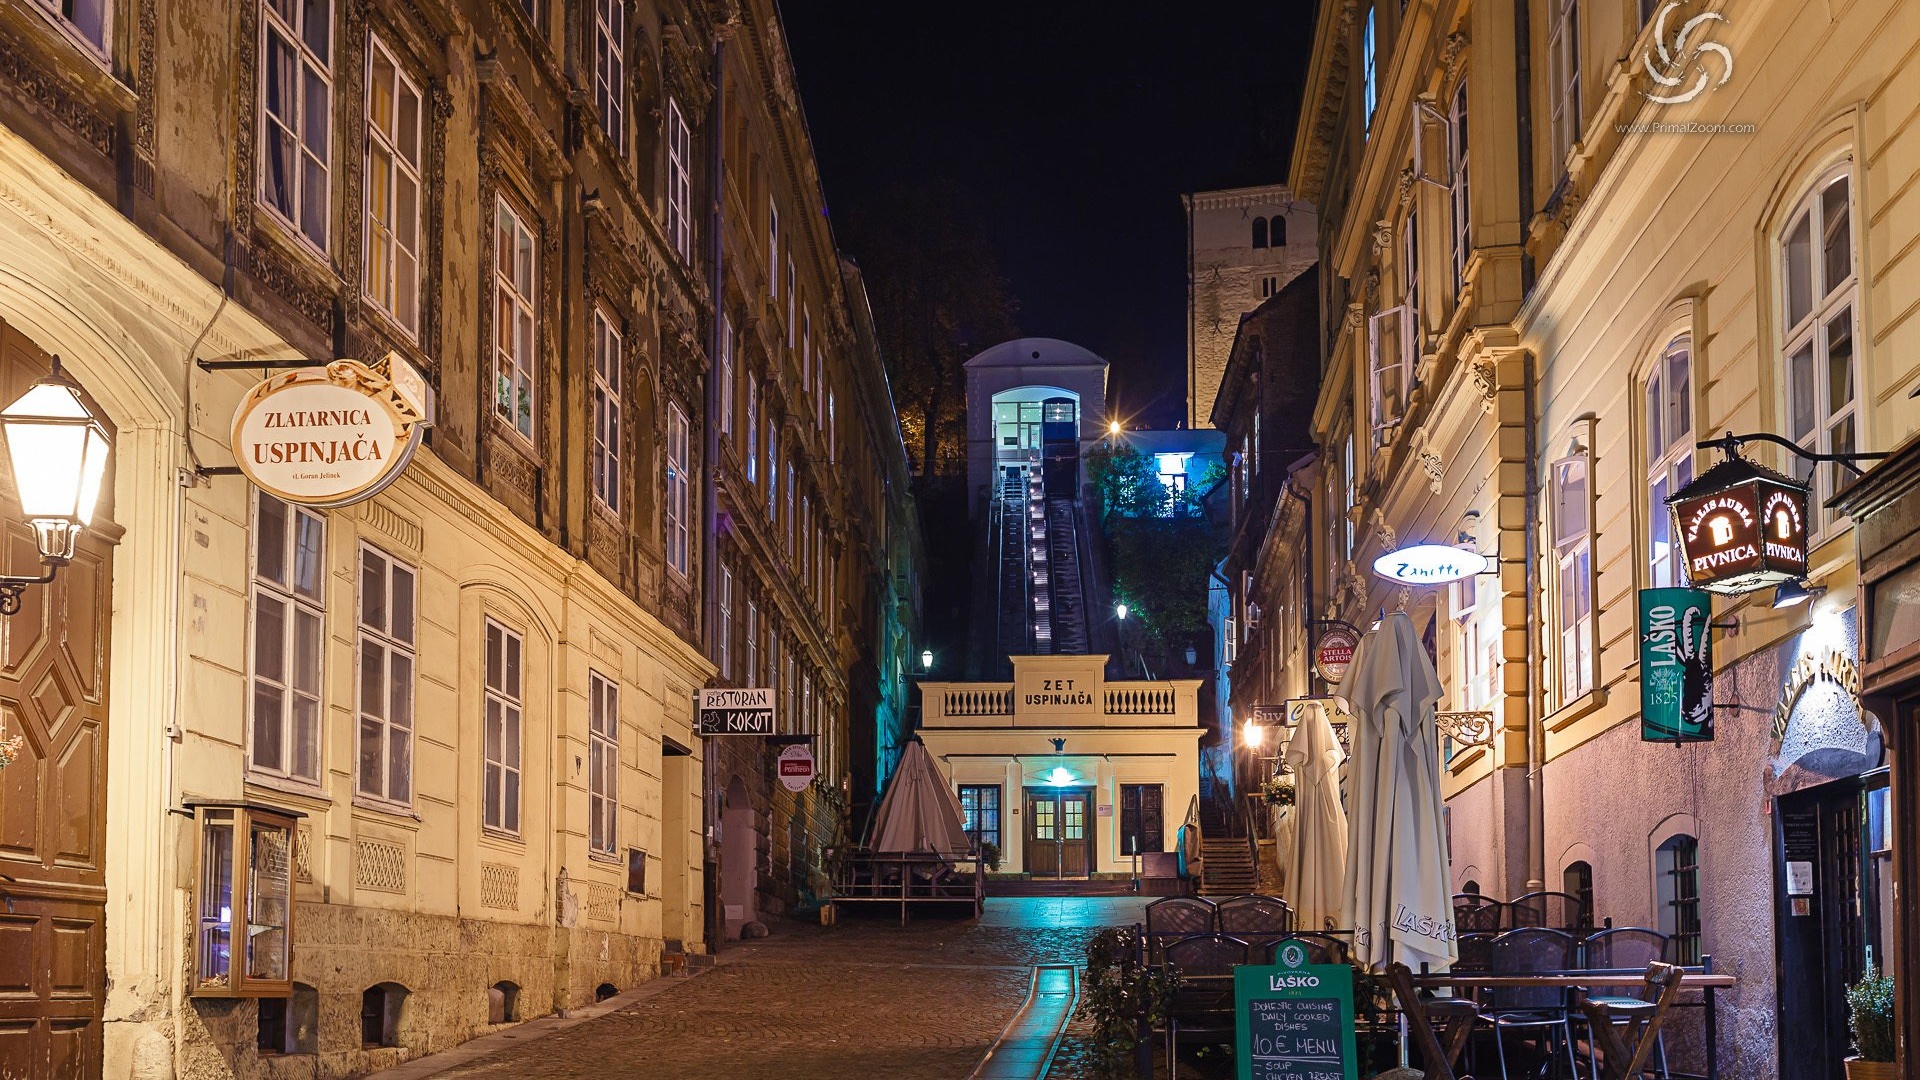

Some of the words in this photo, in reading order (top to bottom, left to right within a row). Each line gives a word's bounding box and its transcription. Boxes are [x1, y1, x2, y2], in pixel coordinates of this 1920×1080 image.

[264, 409, 371, 428] ZLATARNICA
[253, 433, 382, 465] USPINJAČA
[320, 471, 341, 480] Jelinek
[1764, 492, 1782, 525] VALLIS
[1783, 494, 1802, 532] AUREA
[1688, 499, 1717, 543] VALLIS
[1718, 498, 1753, 528] AUREA
[1693, 543, 1758, 571] PIVNICA
[1766, 541, 1802, 562] PIVNICA
[1643, 605, 1676, 667] LAŠKO
[1043, 679, 1074, 690] ZET
[706, 691, 767, 707] RESTORAN
[1025, 691, 1092, 705] USPINJAČA
[1650, 691, 1678, 706] 1825
[1770, 651, 1815, 740] VALLIS
[727, 711, 771, 732] KOKOT
[1392, 904, 1448, 942] LAŠK
[1269, 975, 1320, 991] LAŠKO
[1253, 1002, 1292, 1011] DOMESTIC
[1296, 1003, 1334, 1011] CUISINE
[1261, 1012, 1286, 1022] DAILY
[1294, 1013, 1330, 1022] COOKED
[1274, 1022, 1308, 1031] DISHES
[1296, 1038, 1337, 1055] MENU
[1265, 1061, 1292, 1070] SOUP
[1265, 1072, 1303, 1080] CHICKEN
